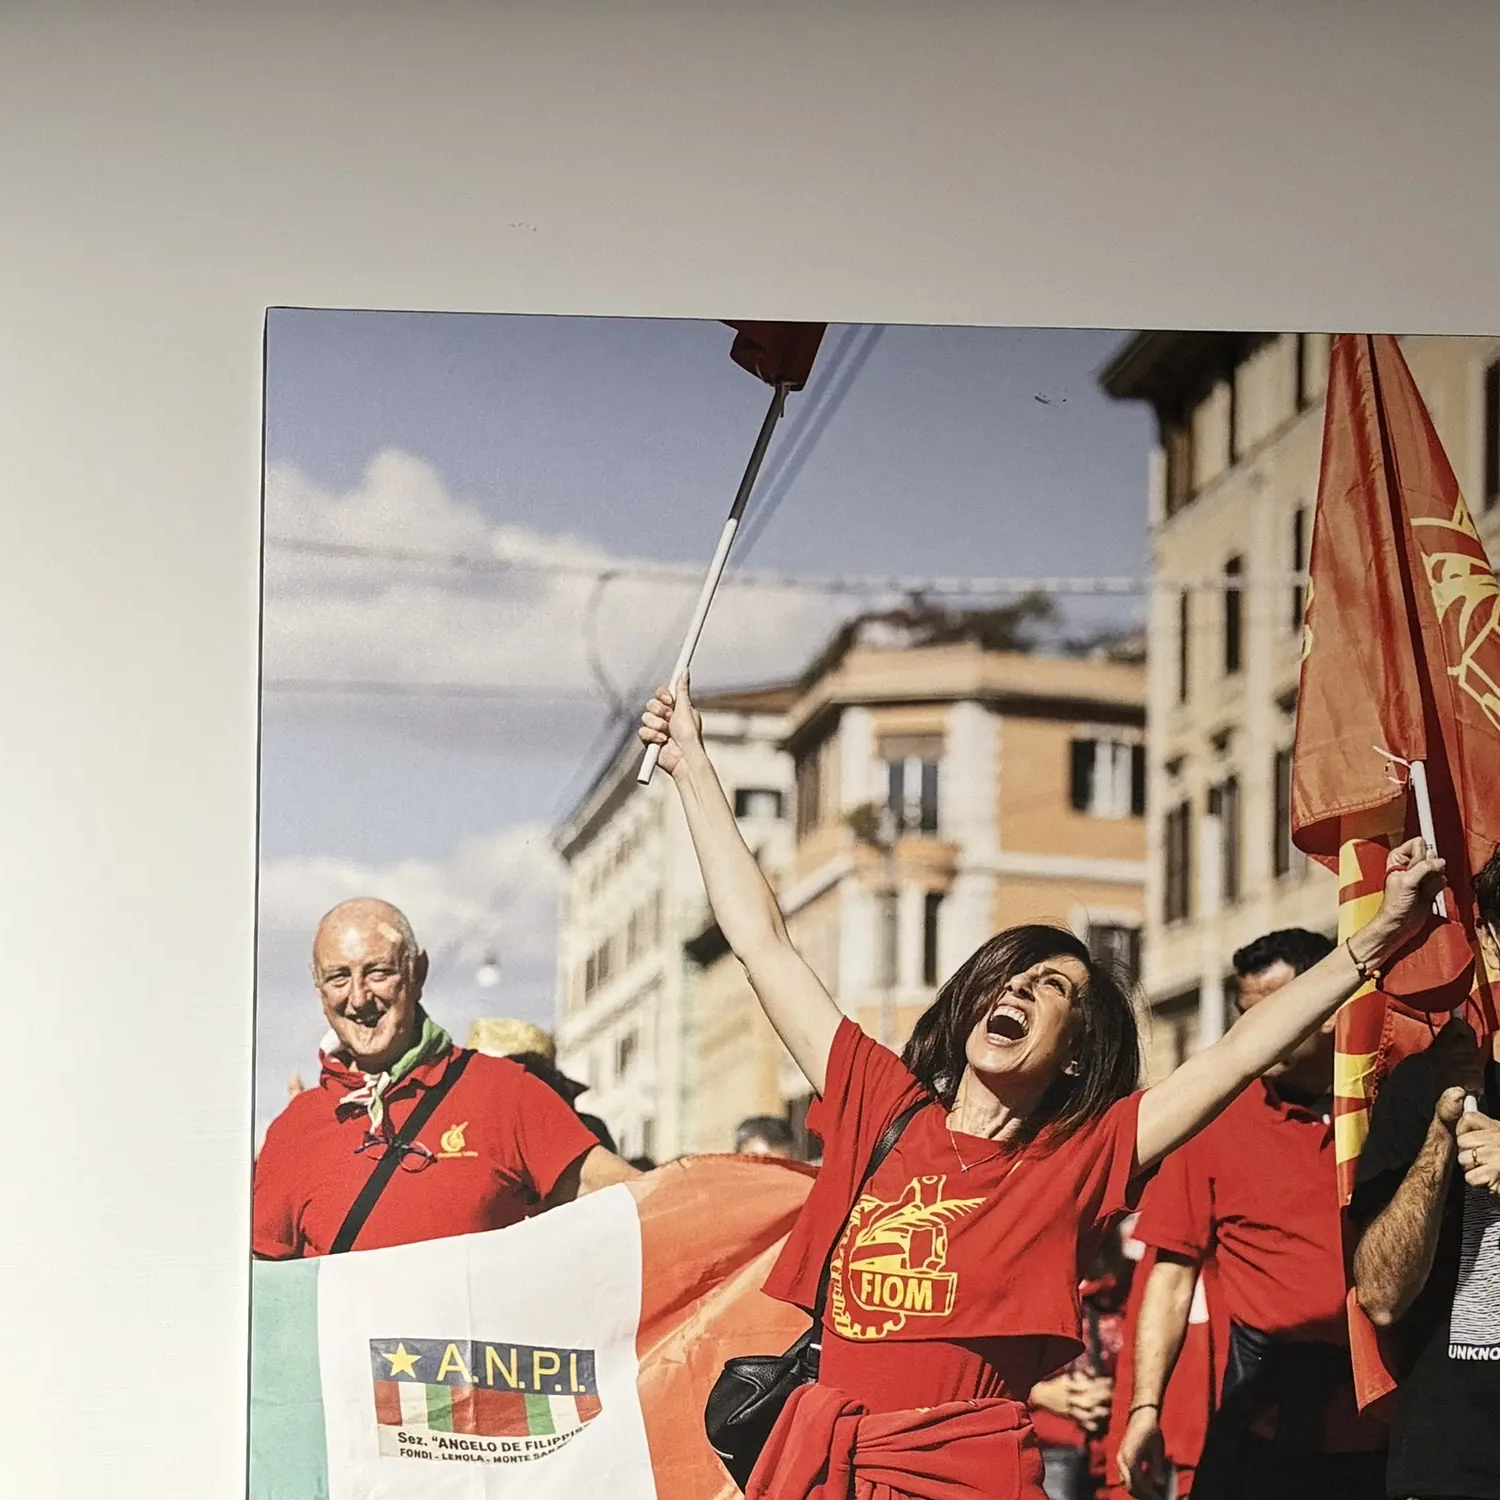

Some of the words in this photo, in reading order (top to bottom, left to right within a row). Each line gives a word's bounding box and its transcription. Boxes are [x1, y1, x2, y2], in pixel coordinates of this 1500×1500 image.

[860, 1272, 933, 1310] FIOM
[436, 1343, 586, 1393] A.N.P.I.
[397, 1431, 428, 1447] Sez.
[500, 1441, 522, 1453] DE
[400, 1448, 433, 1461] FONDI
[493, 1455, 531, 1464] MONTE
